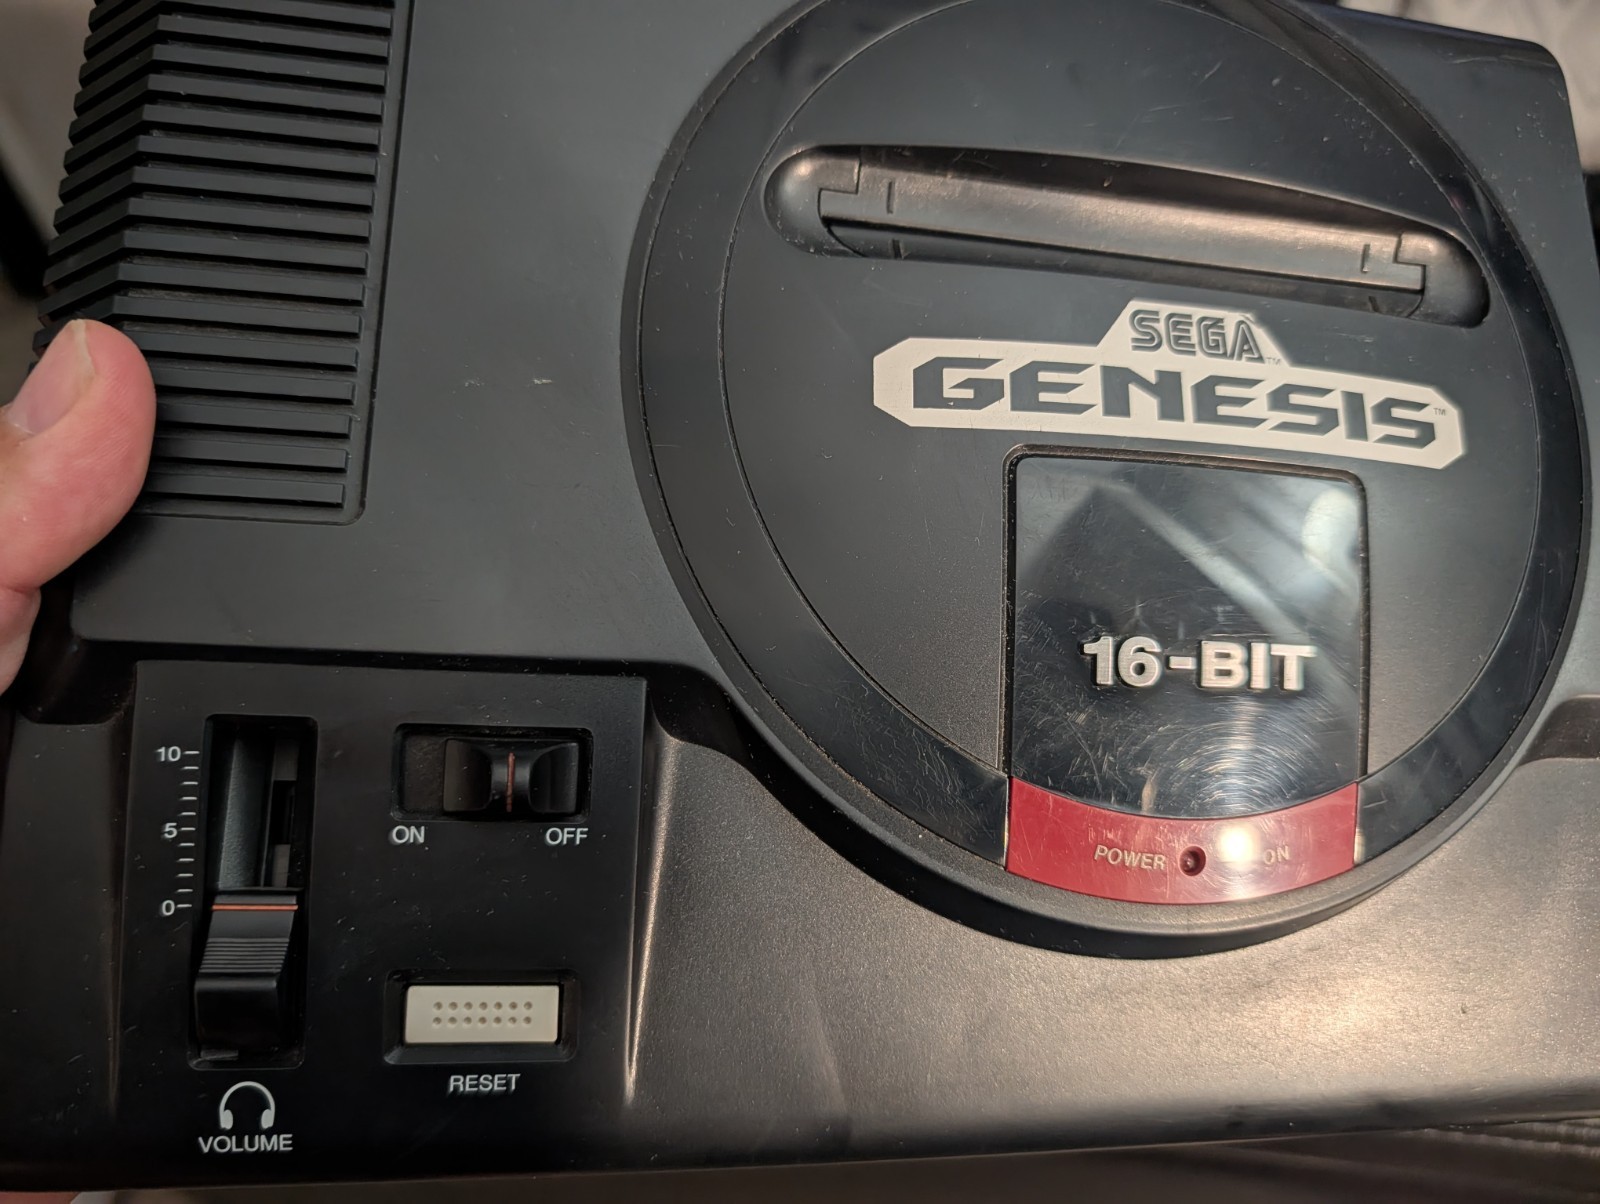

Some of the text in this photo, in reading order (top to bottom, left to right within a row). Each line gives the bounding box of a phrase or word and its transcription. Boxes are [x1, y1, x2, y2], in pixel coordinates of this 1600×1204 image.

[1129, 308, 1265, 364] SEGA
[912, 356, 1446, 450] GENESIS TM
[1082, 635, 1318, 690] 16-BIT
[156, 745, 182, 762] 10
[163, 822, 178, 839] 5
[391, 825, 425, 845] ON
[545, 827, 589, 845] OFF
[1093, 844, 1291, 871] POWER ON
[161, 899, 176, 916] 0
[447, 1073, 521, 1094] RESET
[198, 1133, 294, 1154] VOLUME
